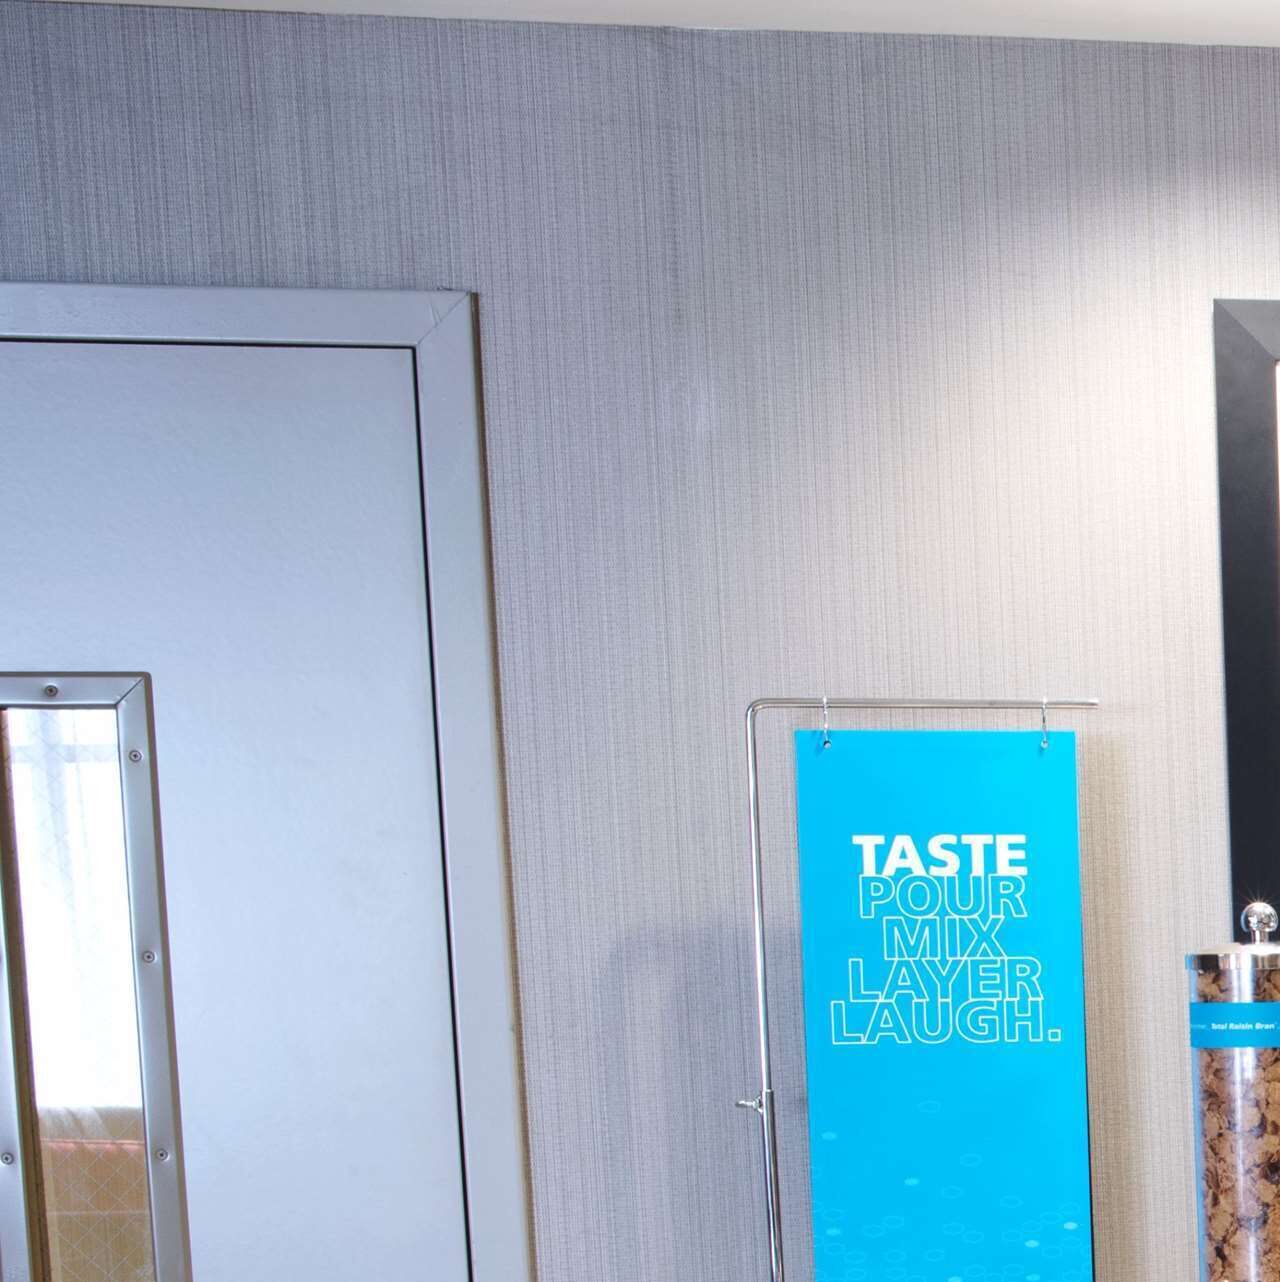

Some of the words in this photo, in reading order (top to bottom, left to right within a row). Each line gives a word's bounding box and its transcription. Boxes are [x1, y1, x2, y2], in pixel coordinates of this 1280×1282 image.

[852, 834, 1029, 876] TASTE
[859, 873, 1028, 919] POUR
[882, 915, 1009, 960] MIX
[848, 956, 1045, 1002] LAYER
[830, 999, 1062, 1045] LAUGH.
[1229, 1022, 1253, 1031] Raisin
[1255, 1022, 1275, 1031] Bran
